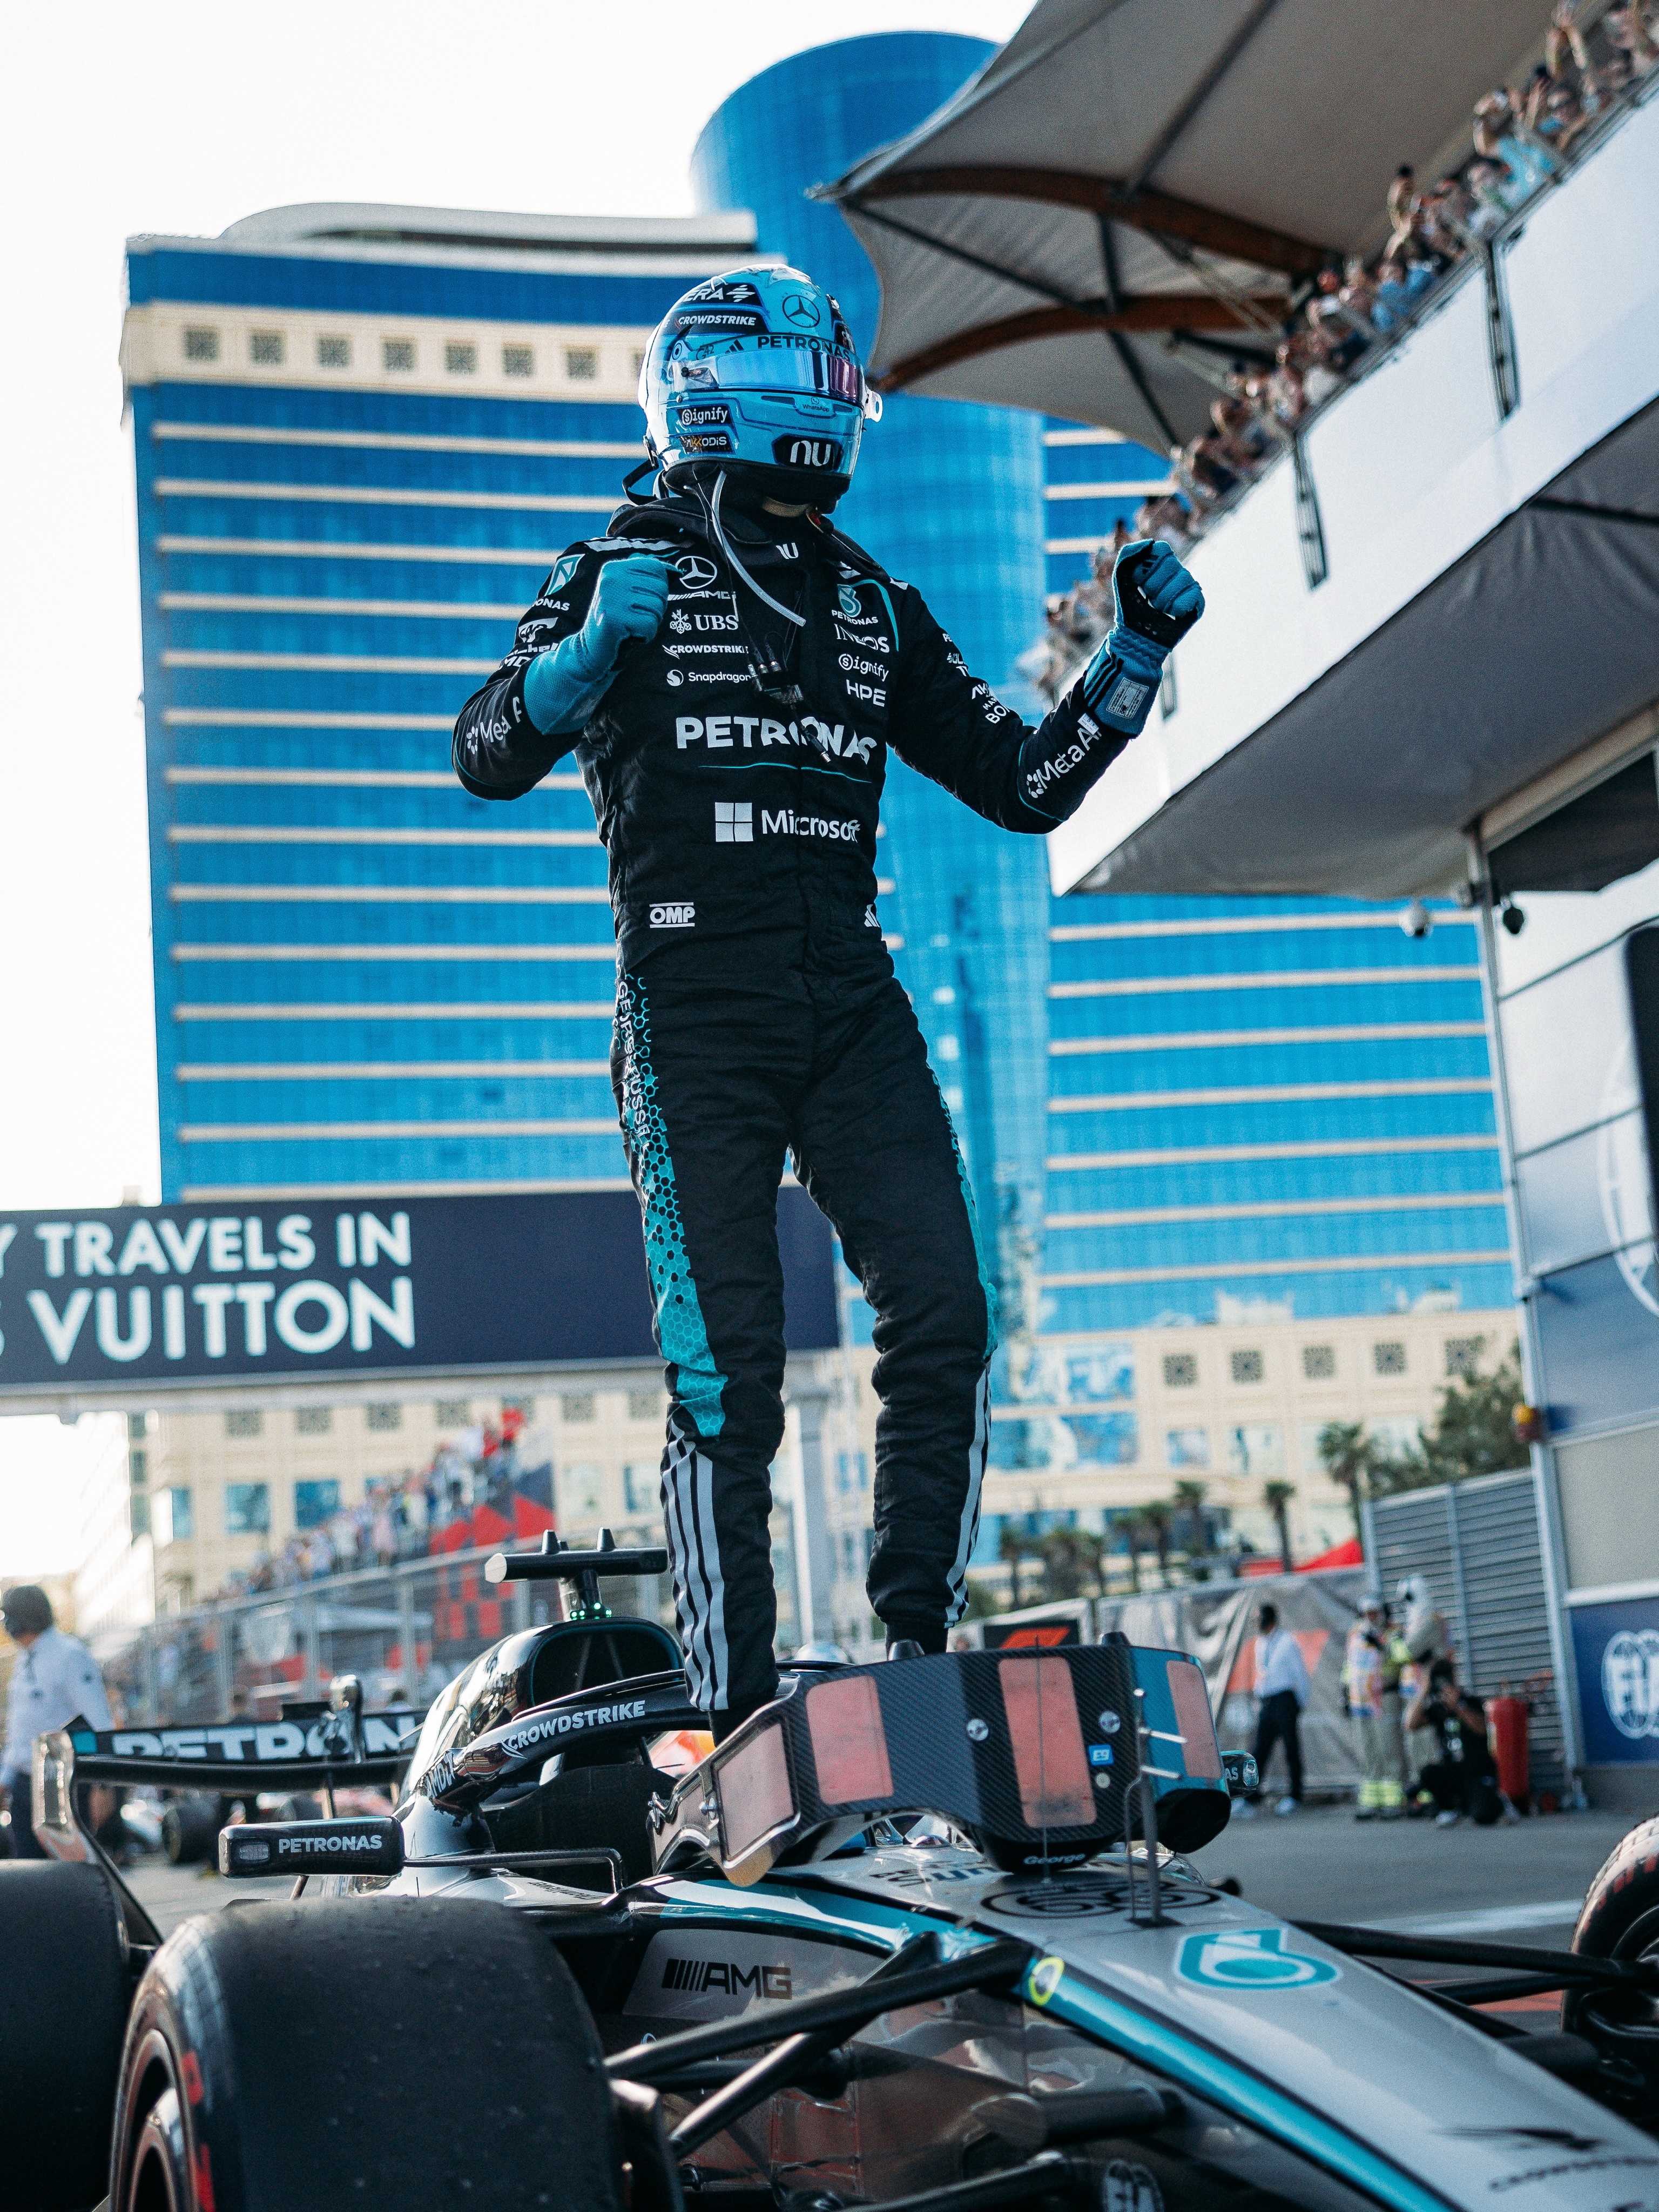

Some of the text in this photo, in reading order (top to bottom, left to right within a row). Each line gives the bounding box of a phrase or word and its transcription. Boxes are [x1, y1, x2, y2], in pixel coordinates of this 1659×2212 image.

[683, 287, 724, 302] ERA
[678, 315, 757, 326] CROWDSTRIKE
[757, 335, 851, 362] PETRONAS
[802, 403, 830, 413] WhatsApp
[532, 598, 570, 611] ONAS
[693, 614, 739, 631] UBS
[831, 609, 879, 625] PETRONAS
[688, 671, 752, 684] Snapdragon
[846, 679, 887, 707] HPE
[676, 716, 878, 765] PETRONAS
[1036, 745, 1085, 790] Meta
[650, 906, 696, 924] OMP
[33, 1213, 318, 1278] TRAVELS
[335, 1211, 412, 1268] IN
[26, 1274, 416, 1365] VUITTON
[508, 1700, 646, 1751] CROWDSTRIKE
[279, 1834, 382, 1854] PETRONAS
[1023, 1853, 1085, 1865] George
[701, 1961, 793, 2001] AMG
